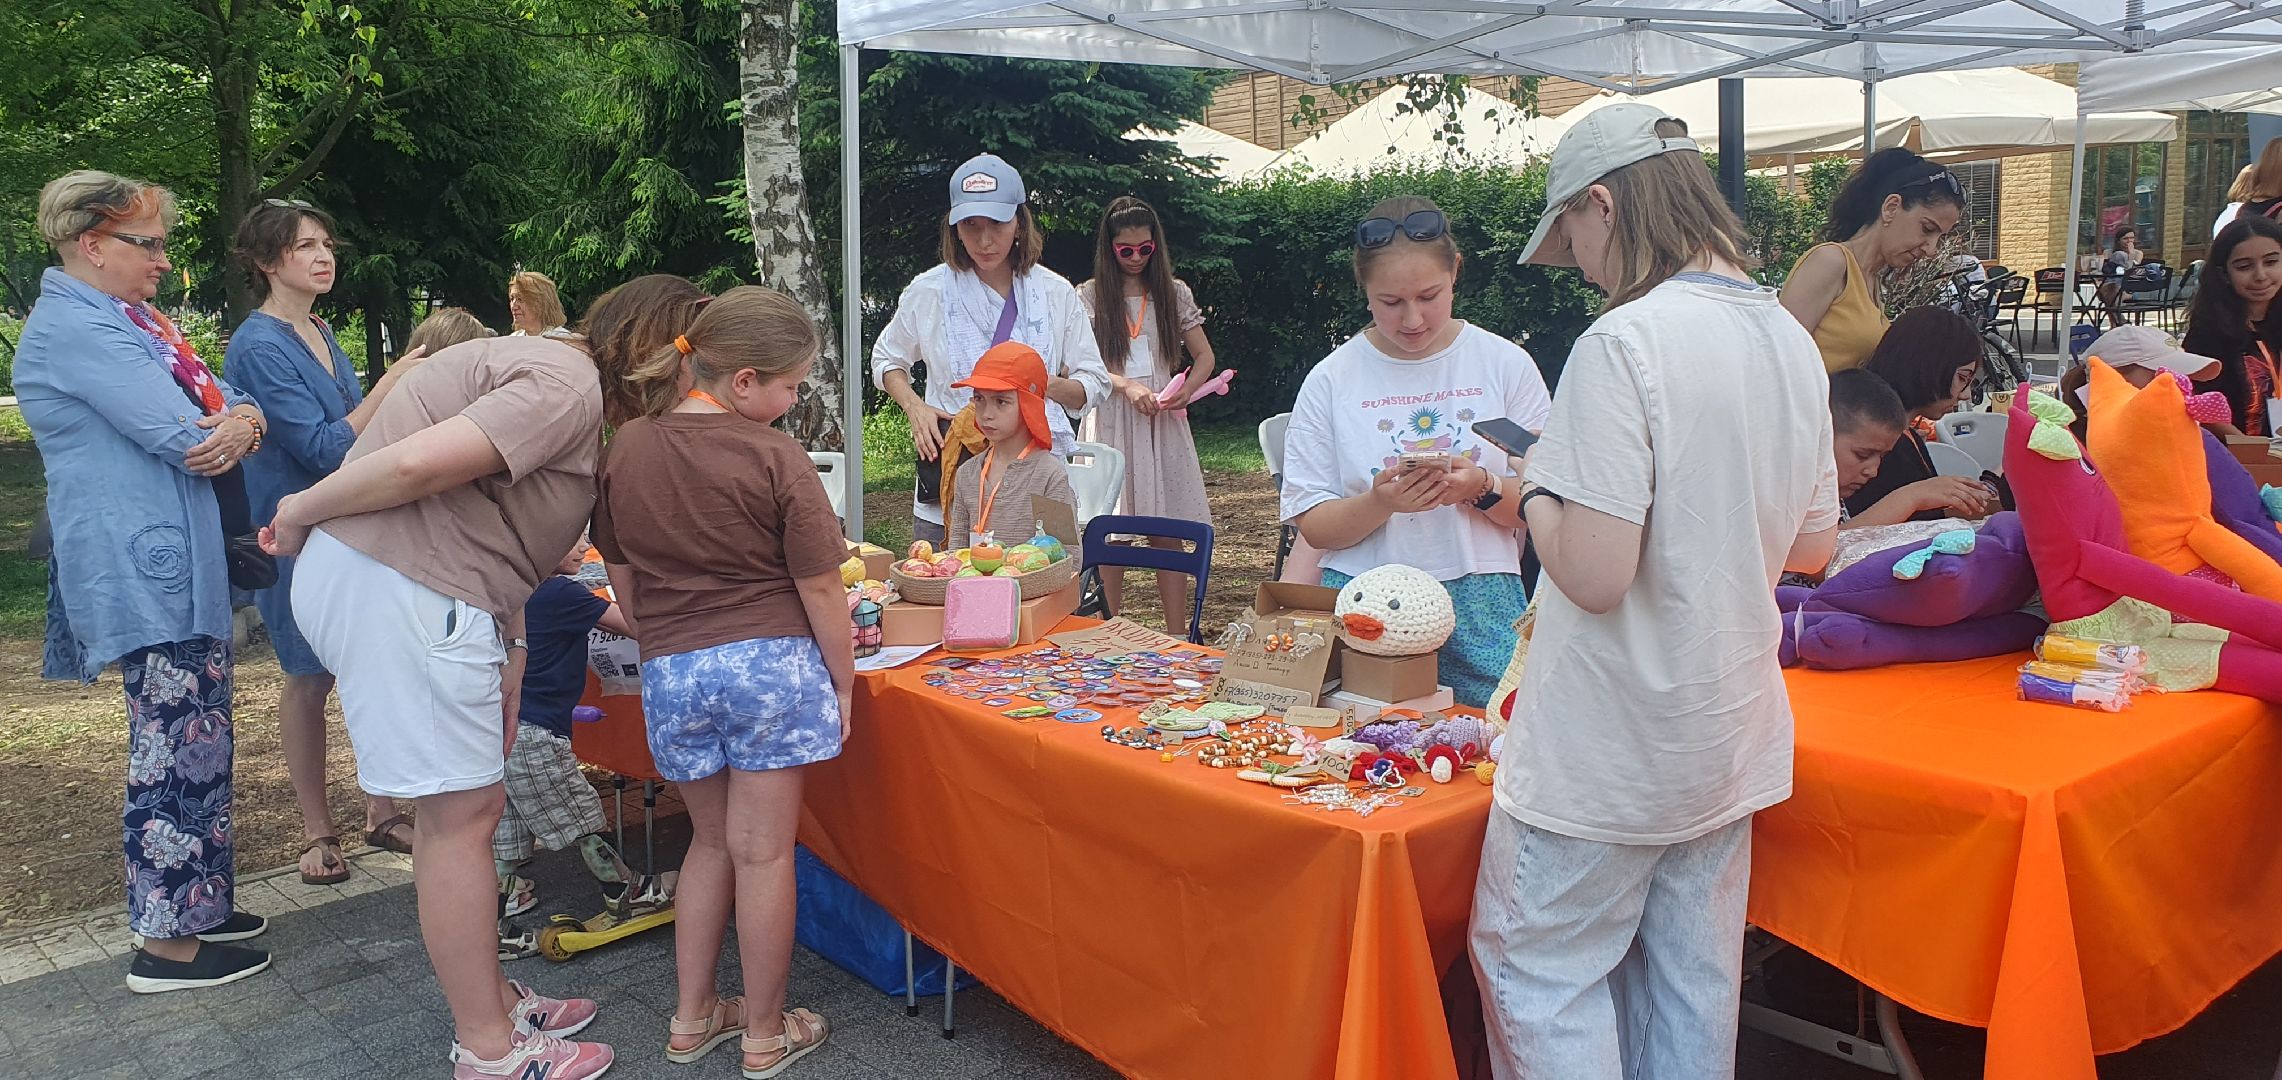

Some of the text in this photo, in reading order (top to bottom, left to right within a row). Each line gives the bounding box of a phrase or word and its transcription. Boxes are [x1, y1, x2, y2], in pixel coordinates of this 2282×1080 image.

[1361, 387, 1483, 409] SUNSHINE MAKES
[1098, 621, 1172, 649] АКЦИЯ
[529, 1012, 547, 1030] N
[521, 1060, 551, 1080] N
